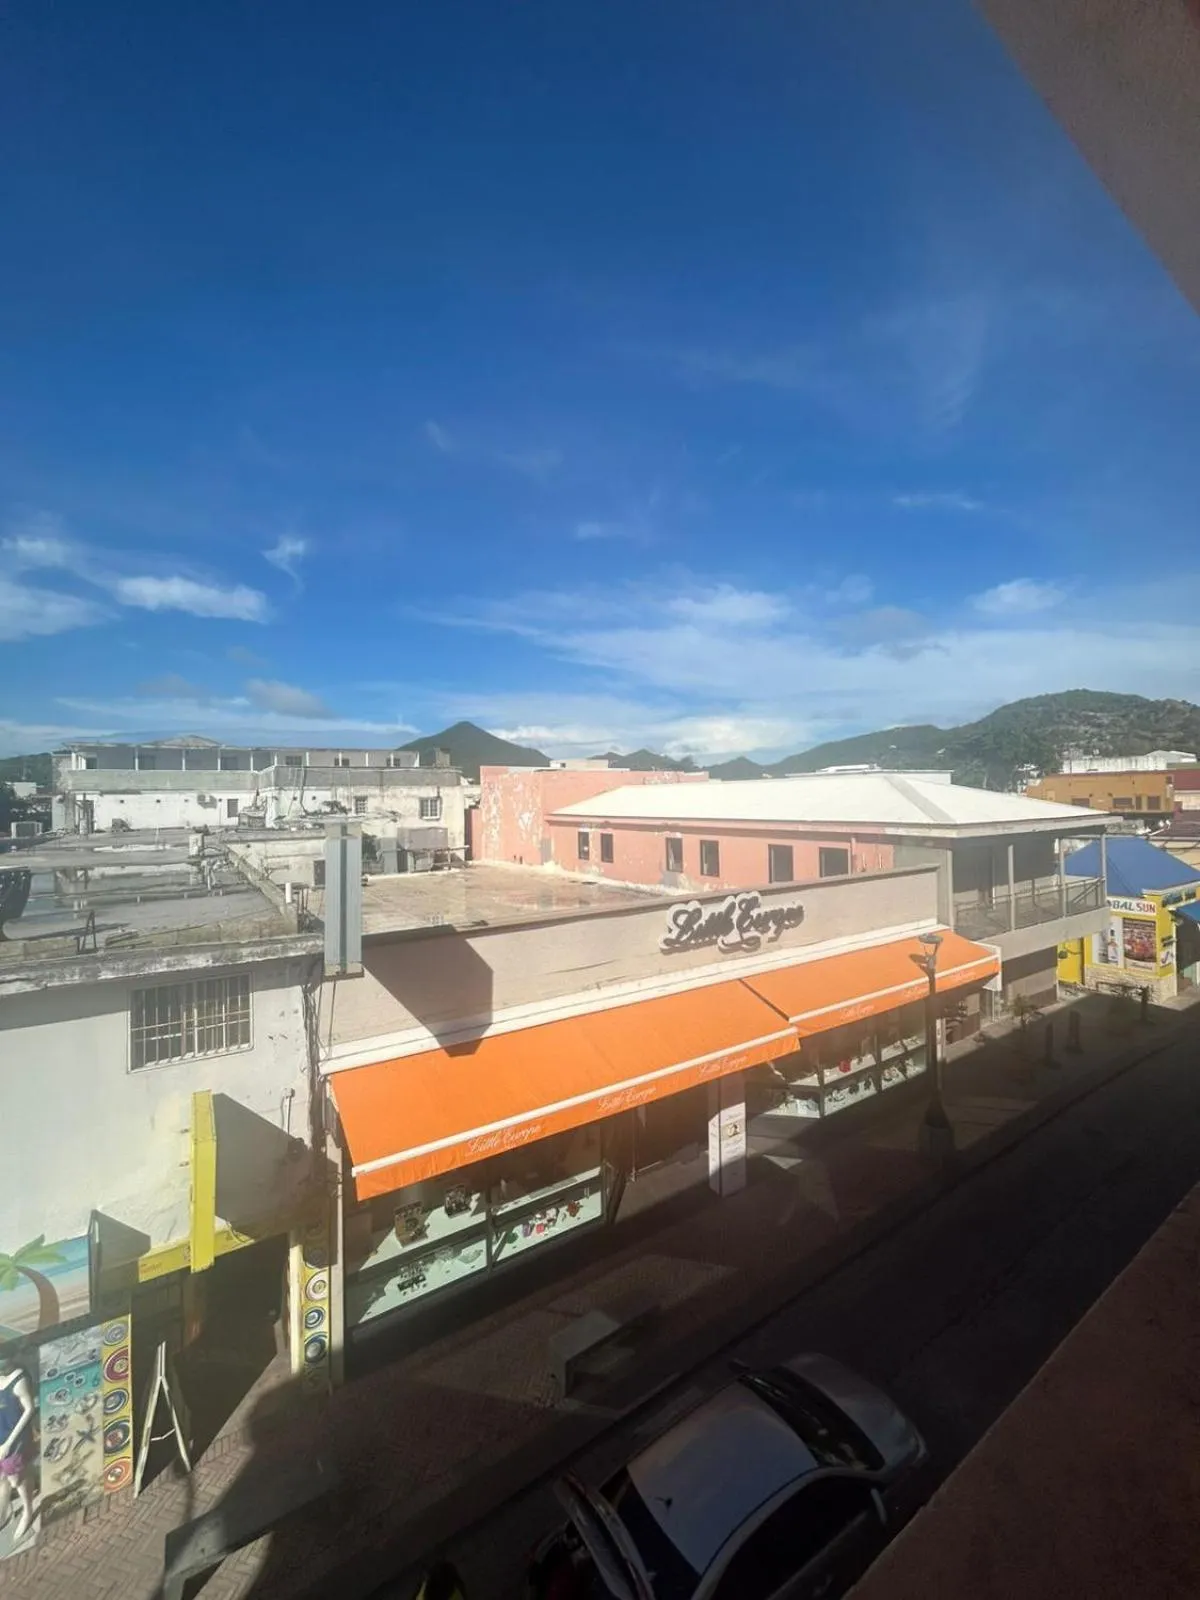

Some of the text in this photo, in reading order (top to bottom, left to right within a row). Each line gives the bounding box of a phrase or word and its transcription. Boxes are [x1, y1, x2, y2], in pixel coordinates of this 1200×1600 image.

[1135, 903, 1156, 914] SUN
[662, 895, 805, 954] Little Europe
[466, 1125, 542, 1156] Little Europe
